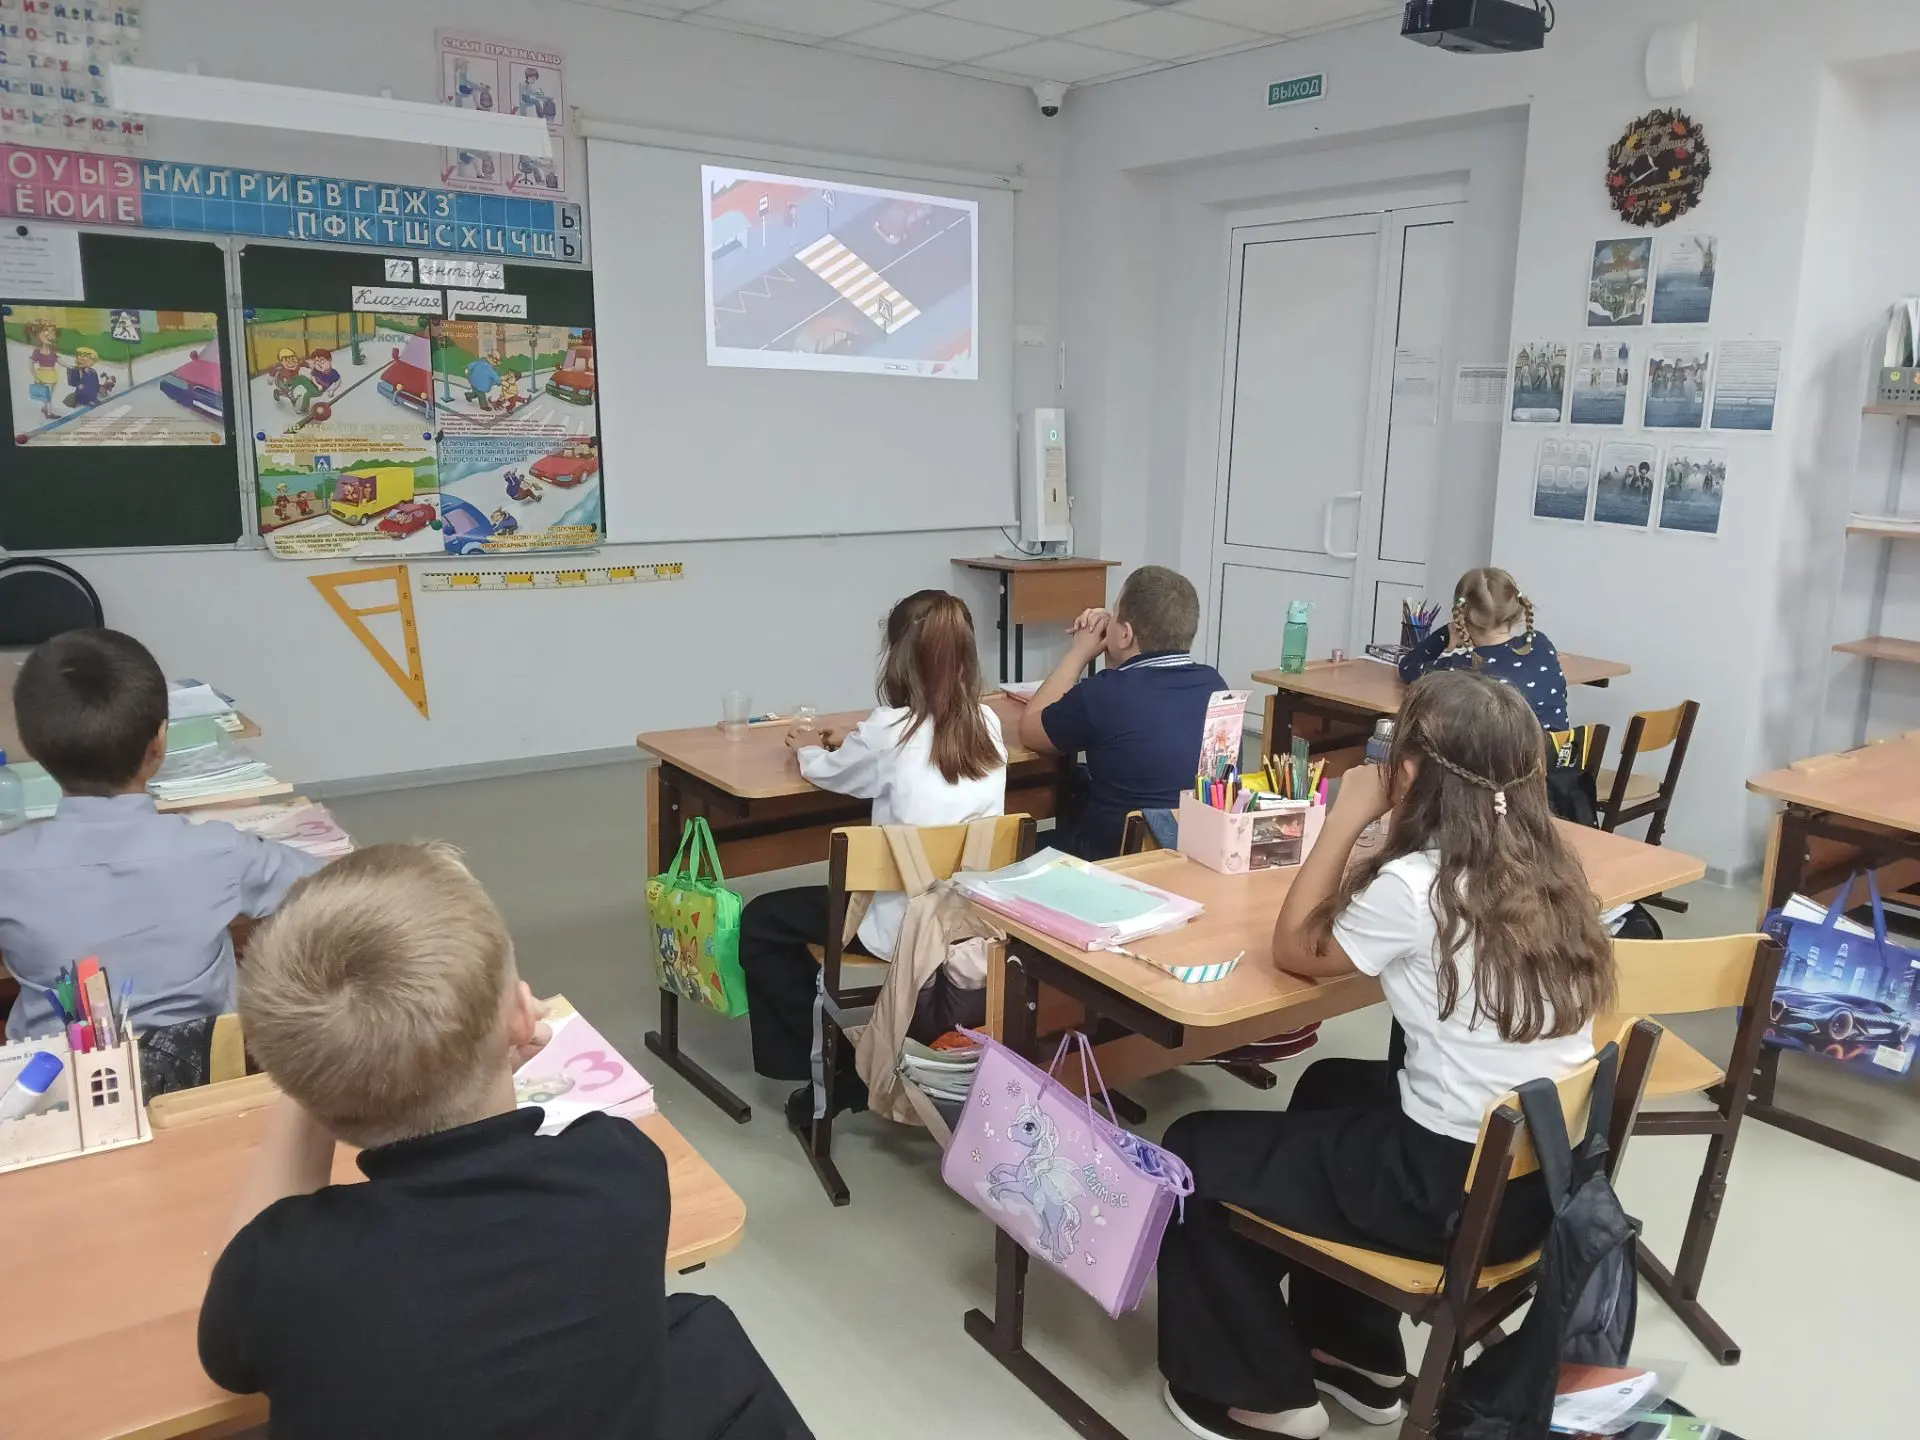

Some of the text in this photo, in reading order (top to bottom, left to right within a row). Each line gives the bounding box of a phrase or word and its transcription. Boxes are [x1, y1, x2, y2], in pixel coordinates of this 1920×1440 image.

[1271, 79, 1320, 101] ВЫХОД
[388, 261, 411, 278] 17
[354, 288, 441, 310] Классная
[563, 1050, 624, 1093] 3
